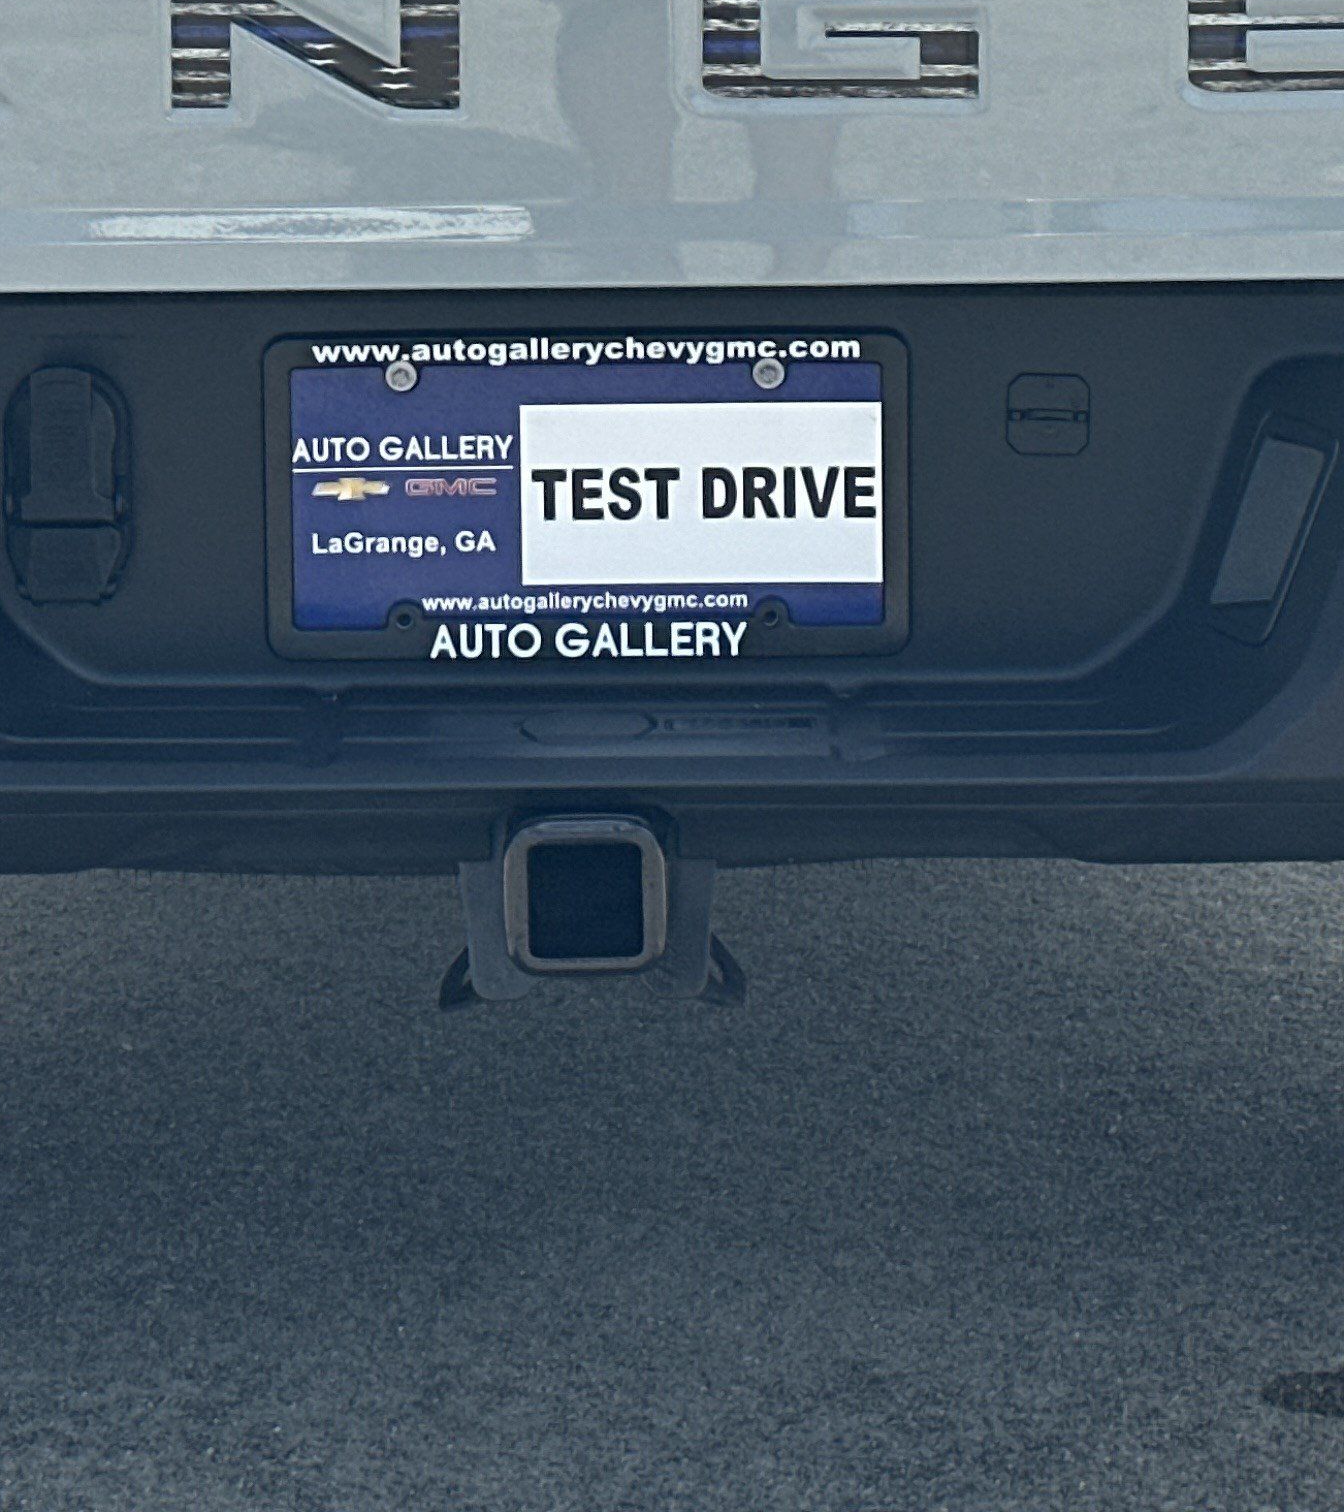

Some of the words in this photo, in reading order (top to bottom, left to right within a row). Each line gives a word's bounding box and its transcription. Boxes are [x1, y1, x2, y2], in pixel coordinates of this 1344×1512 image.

[312, 338, 861, 367] www.autogallerychevygmc.com
[293, 437, 370, 464] AUTO
[379, 434, 513, 462] GALLERY
[405, 478, 497, 496] GMC
[532, 469, 679, 520] TEST
[703, 466, 876, 519] DRIVE
[312, 532, 447, 556] LaGrange,
[455, 531, 497, 553] GA
[421, 592, 748, 614] www.autogallerychevygmc.com
[430, 624, 542, 659] AUTO
[555, 622, 748, 657] GALLERY
